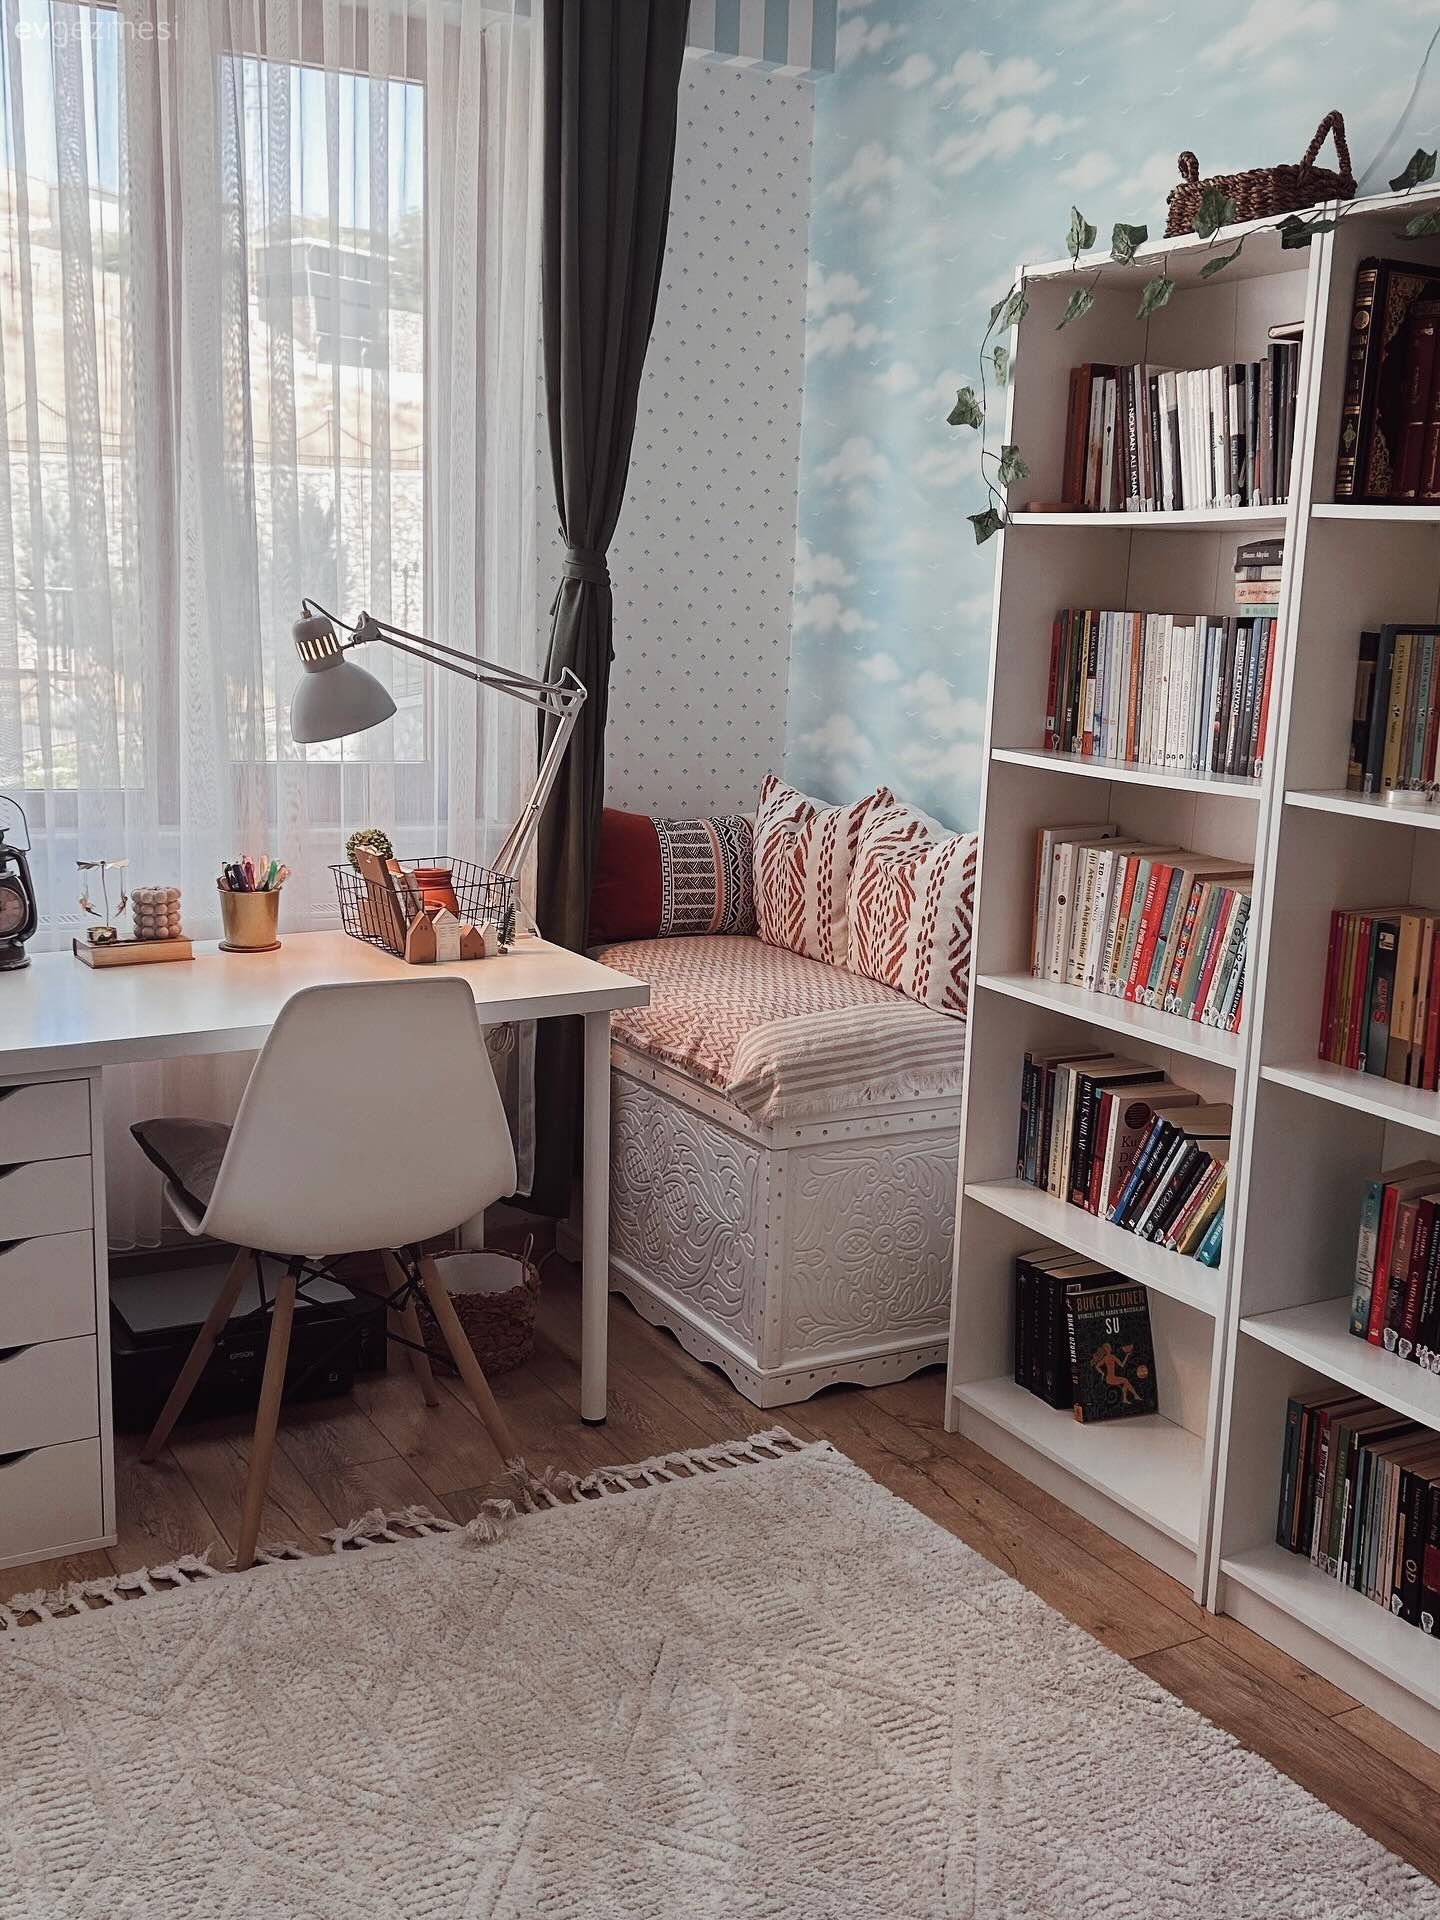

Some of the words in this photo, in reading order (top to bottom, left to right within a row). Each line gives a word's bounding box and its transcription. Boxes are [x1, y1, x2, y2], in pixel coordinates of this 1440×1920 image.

[1233, 682, 1242, 715] UYUYAN
[1097, 862, 1105, 875] TED
[1085, 868, 1095, 902] Atomik
[1078, 905, 1091, 958] Alışkanlıklar
[1077, 1294, 1106, 1312] BUKET
[1406, 1271, 1419, 1312] CAMDAKİ
[1067, 1313, 1076, 1335] BUKET
[1105, 1317, 1120, 1335] SU
[1404, 1313, 1414, 1329] KIZ
[230, 1350, 254, 1360] EPSON
[1068, 1336, 1077, 1363] UZUNER
[1405, 1559, 1418, 1584] OD
